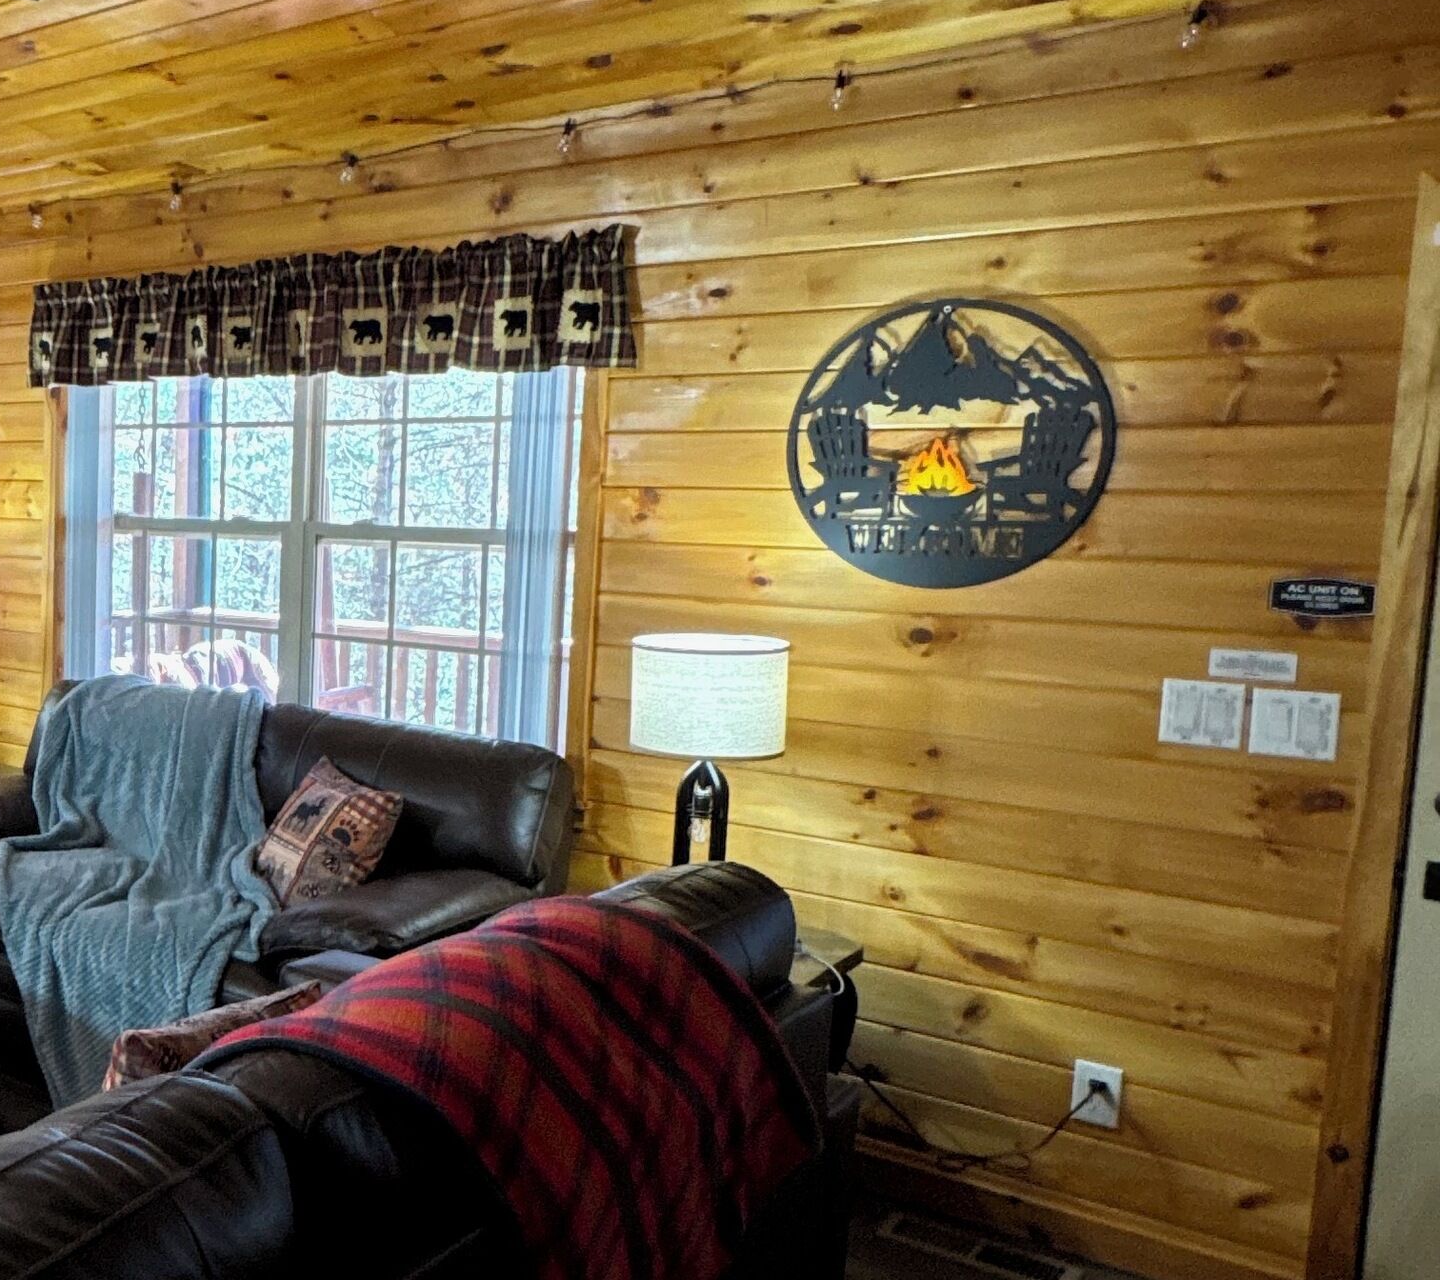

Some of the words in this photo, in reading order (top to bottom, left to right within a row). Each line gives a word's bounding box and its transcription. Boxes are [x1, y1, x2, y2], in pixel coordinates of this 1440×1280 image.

[845, 524, 1025, 560] WELCOME
[1287, 584, 1306, 593] AC
[1308, 585, 1337, 594] UNIT
